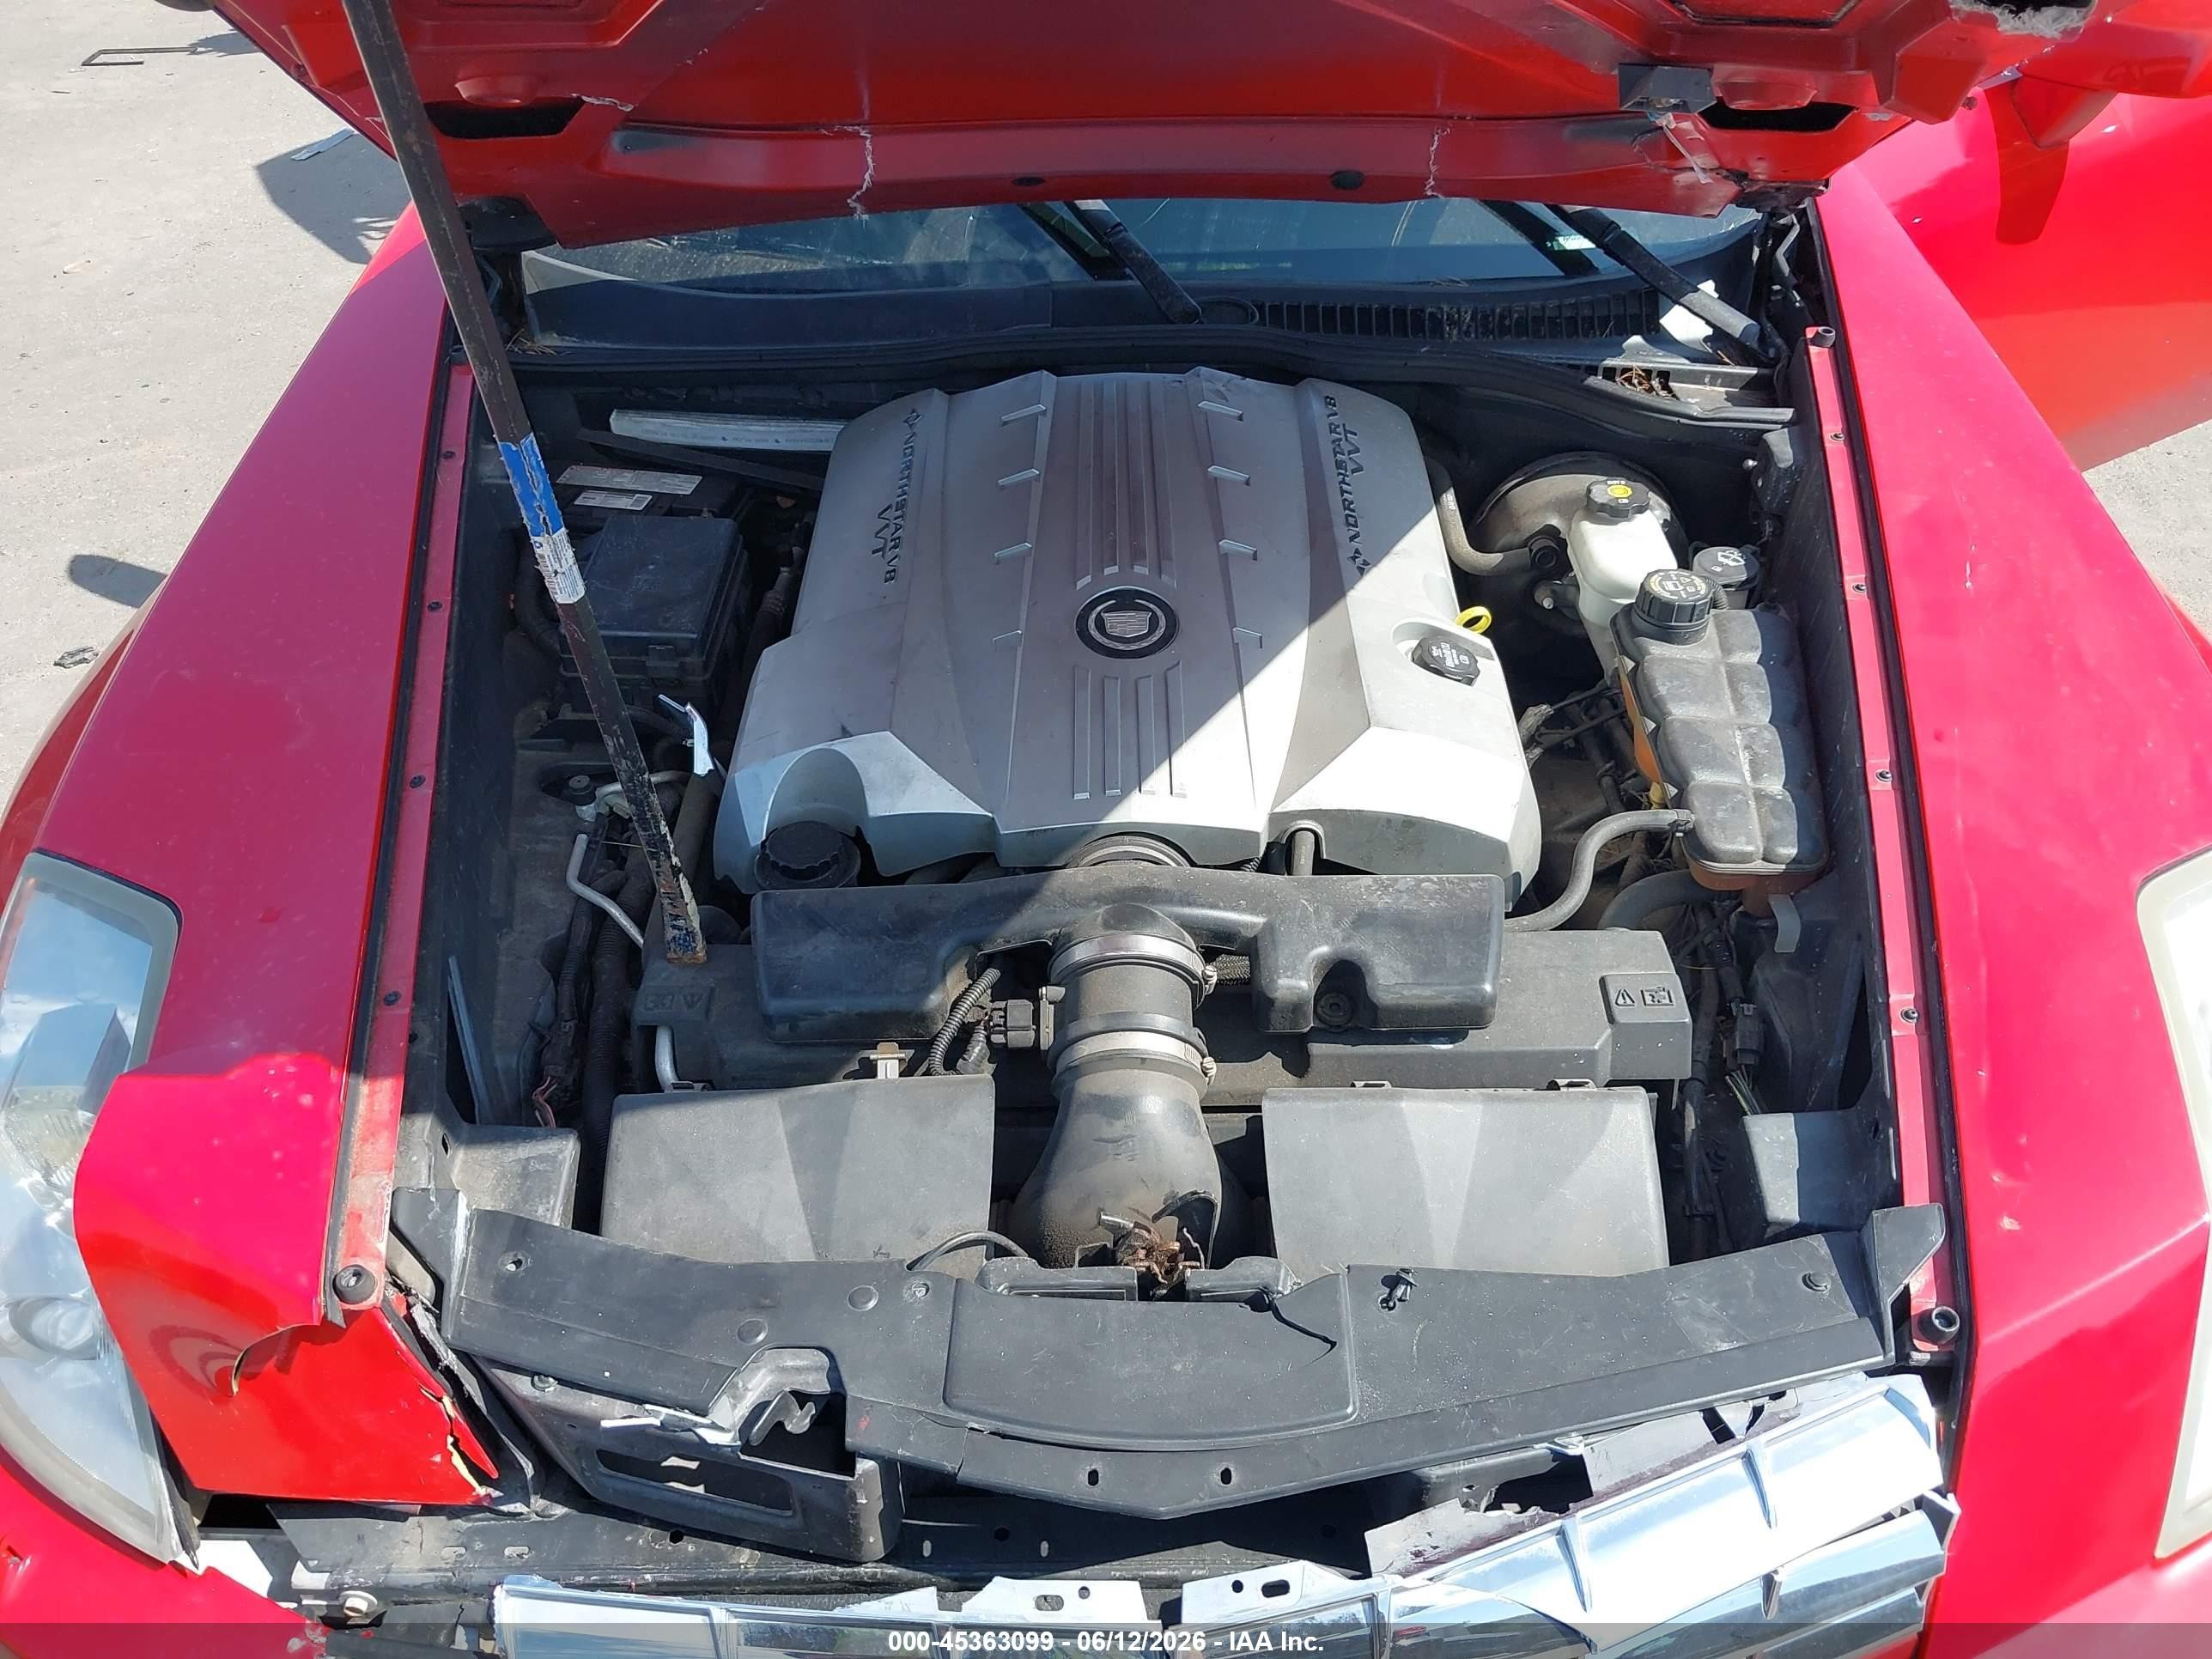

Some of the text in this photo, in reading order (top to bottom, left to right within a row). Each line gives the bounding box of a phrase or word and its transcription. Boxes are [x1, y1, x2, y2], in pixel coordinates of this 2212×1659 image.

[889, 432, 916, 550] NORTHSTAR
[1328, 422, 1362, 544] NORTHSTAR
[1342, 422, 1364, 475] VVT
[872, 503, 893, 559] VVT
